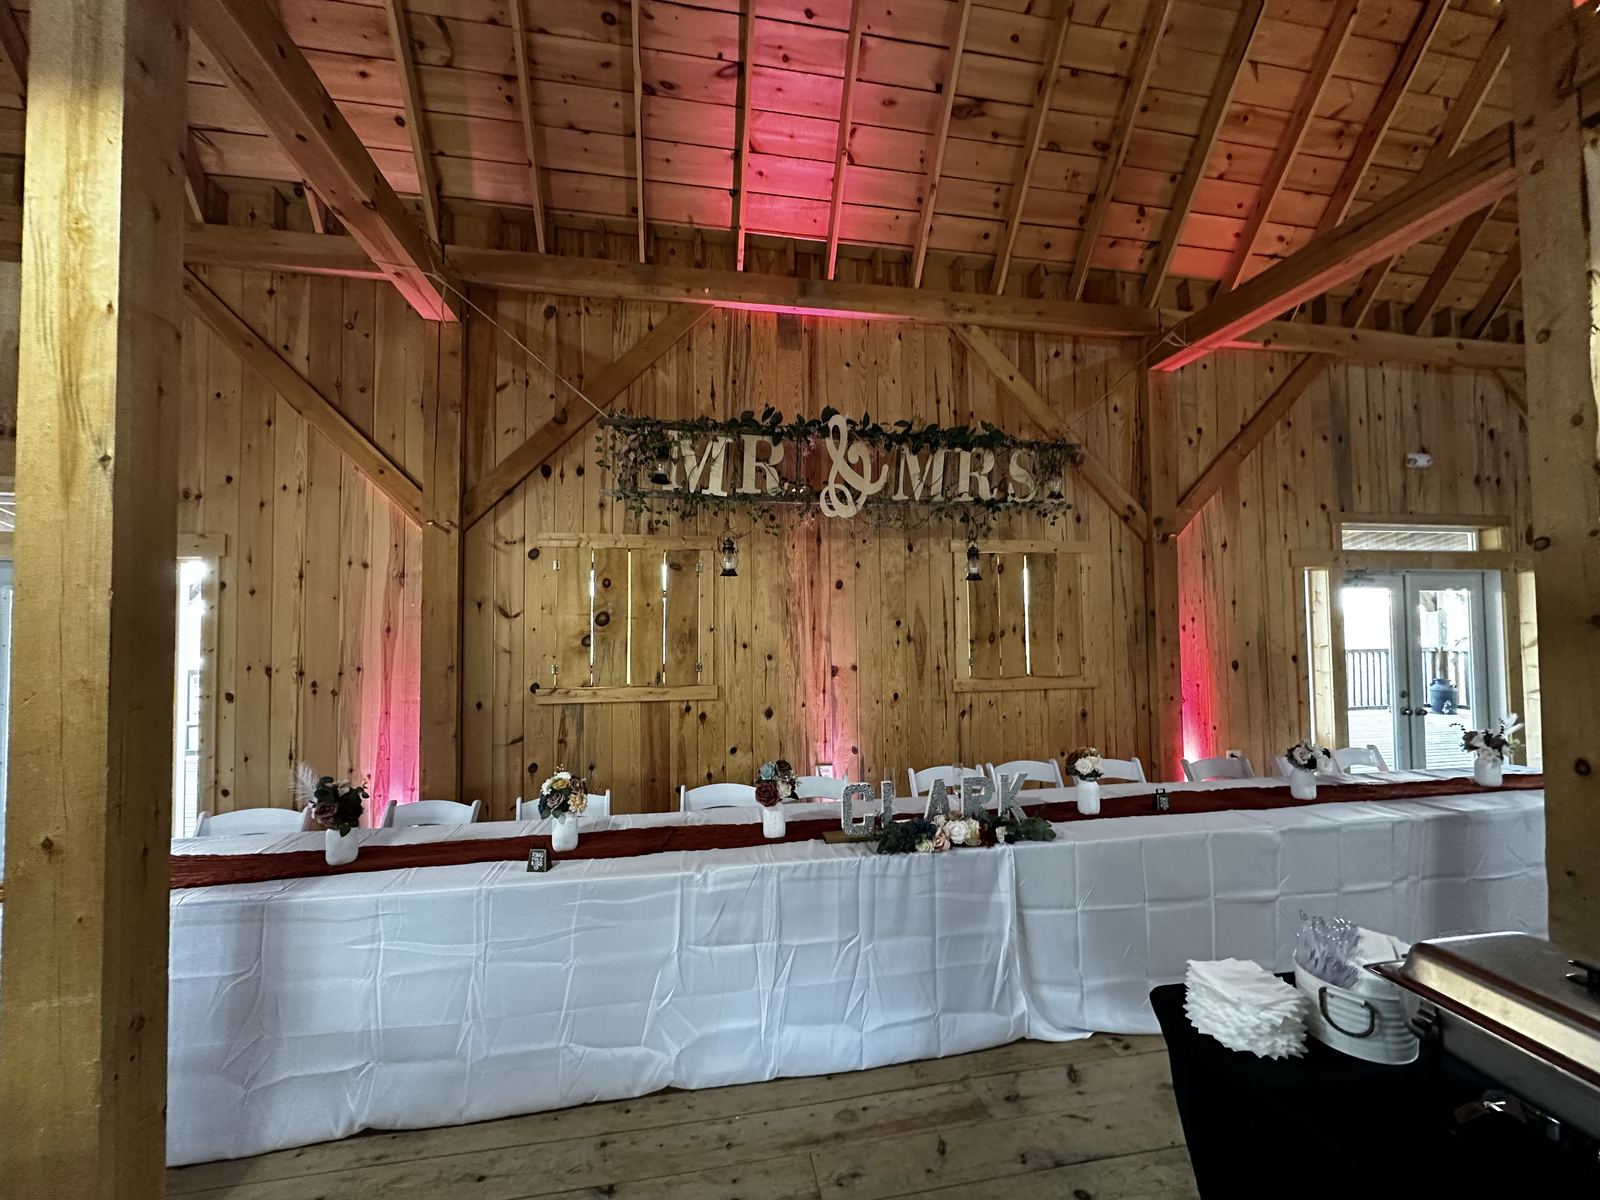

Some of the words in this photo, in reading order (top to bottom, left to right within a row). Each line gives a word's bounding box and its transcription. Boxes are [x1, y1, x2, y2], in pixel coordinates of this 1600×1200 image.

[663, 430, 786, 497] MR
[820, 414, 889, 518] &
[892, 446, 1038, 502] MRS
